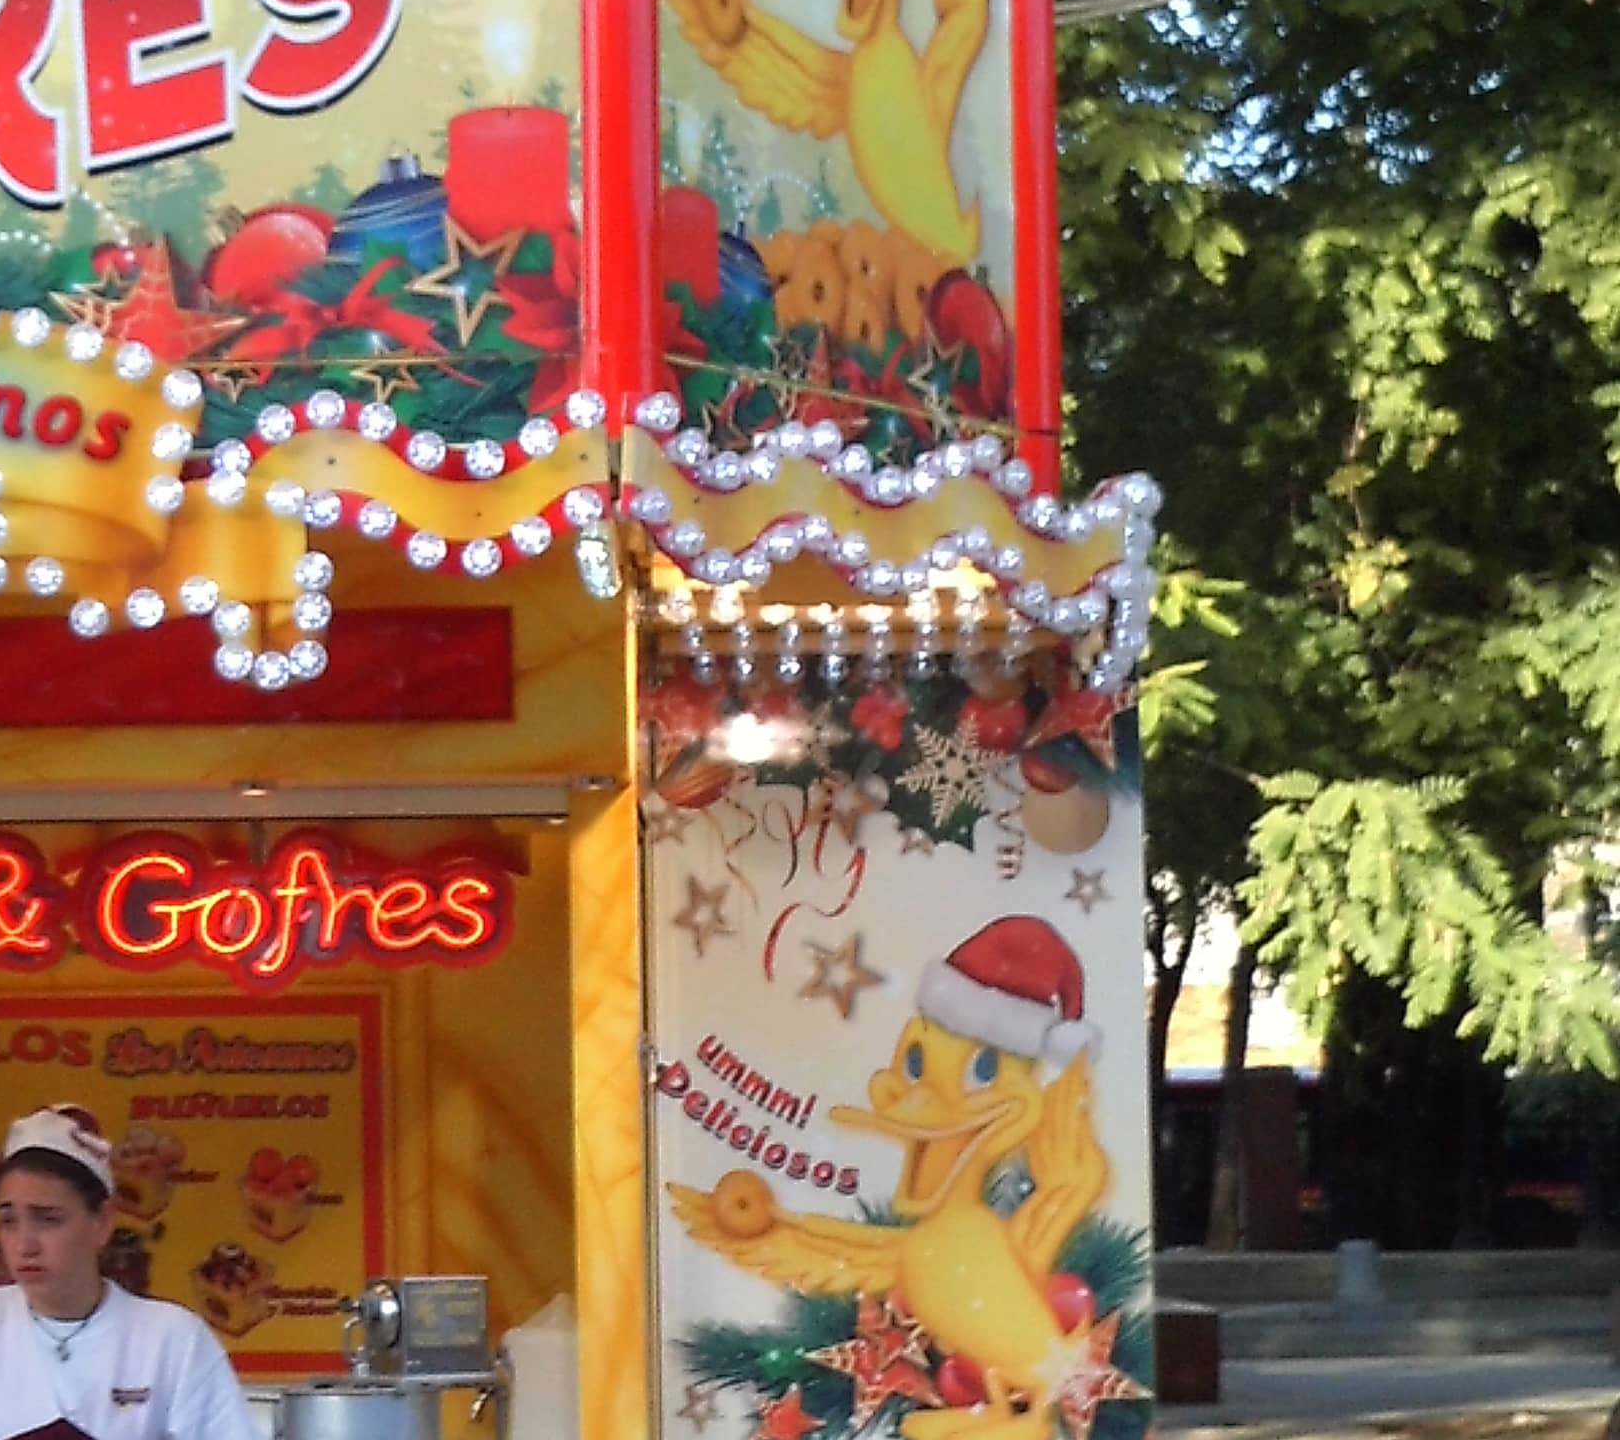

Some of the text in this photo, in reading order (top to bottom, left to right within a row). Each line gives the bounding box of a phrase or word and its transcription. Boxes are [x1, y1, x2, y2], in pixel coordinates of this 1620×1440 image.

[94, 846, 498, 978] Gofres
[656, 1060, 860, 1196] Deliciosos
[696, 1034, 818, 1130] ummm!
